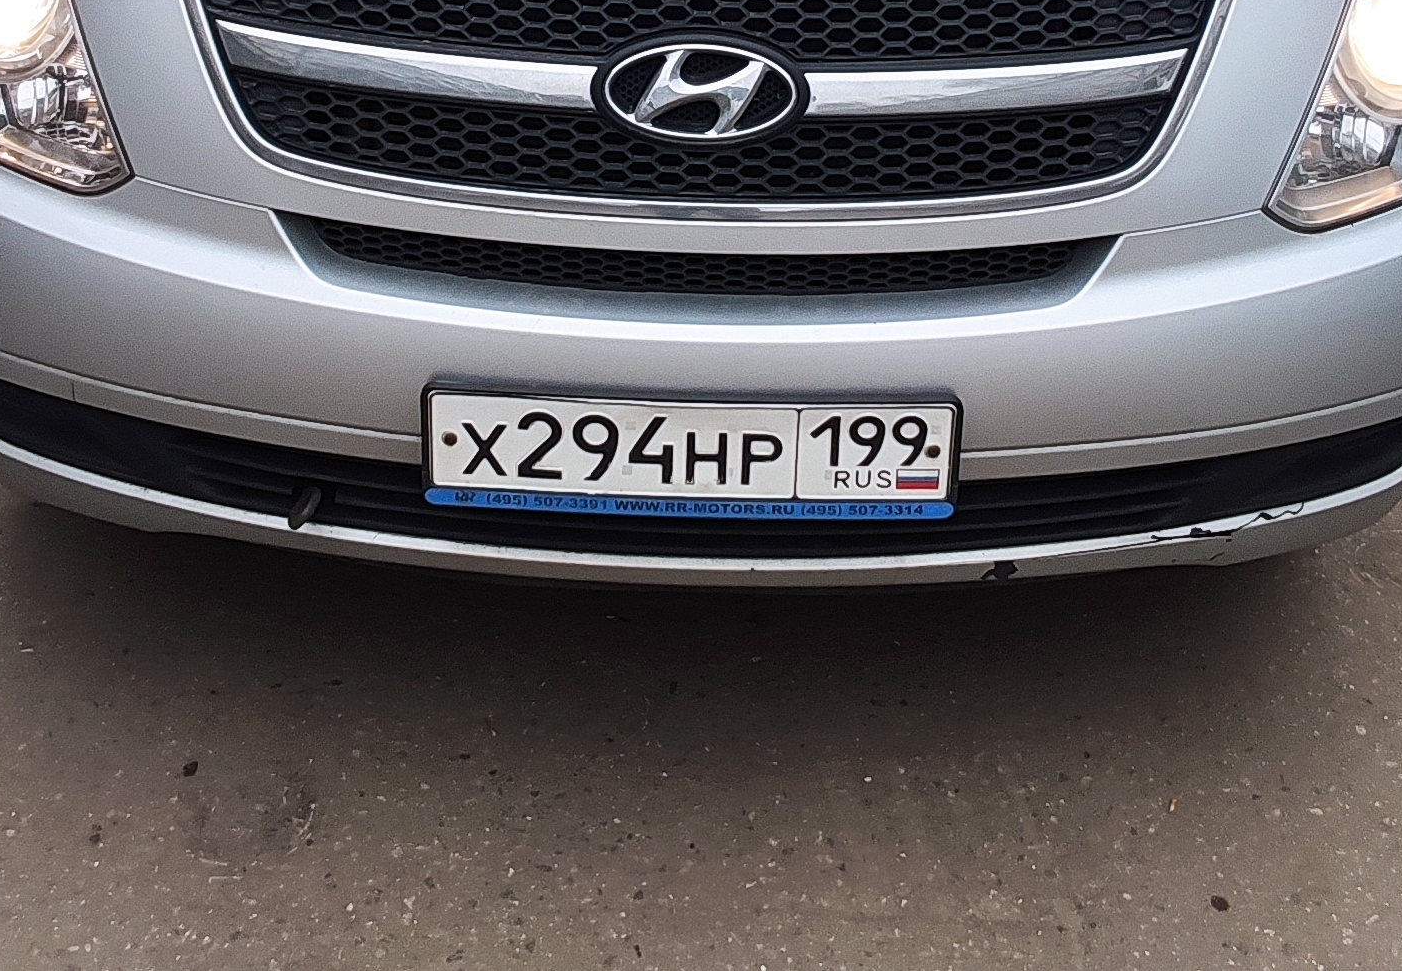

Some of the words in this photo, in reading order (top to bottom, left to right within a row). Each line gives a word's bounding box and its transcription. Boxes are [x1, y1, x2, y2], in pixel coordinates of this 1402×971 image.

[461, 411, 783, 486] Х294НР
[809, 415, 929, 467] 199
[833, 469, 892, 489] RUS
[486, 493, 528, 508] (495)
[614, 499, 795, 516] WWW.RR-MOTORS.RU
[800, 503, 843, 517] (495)
[847, 504, 924, 517] 507-3314
